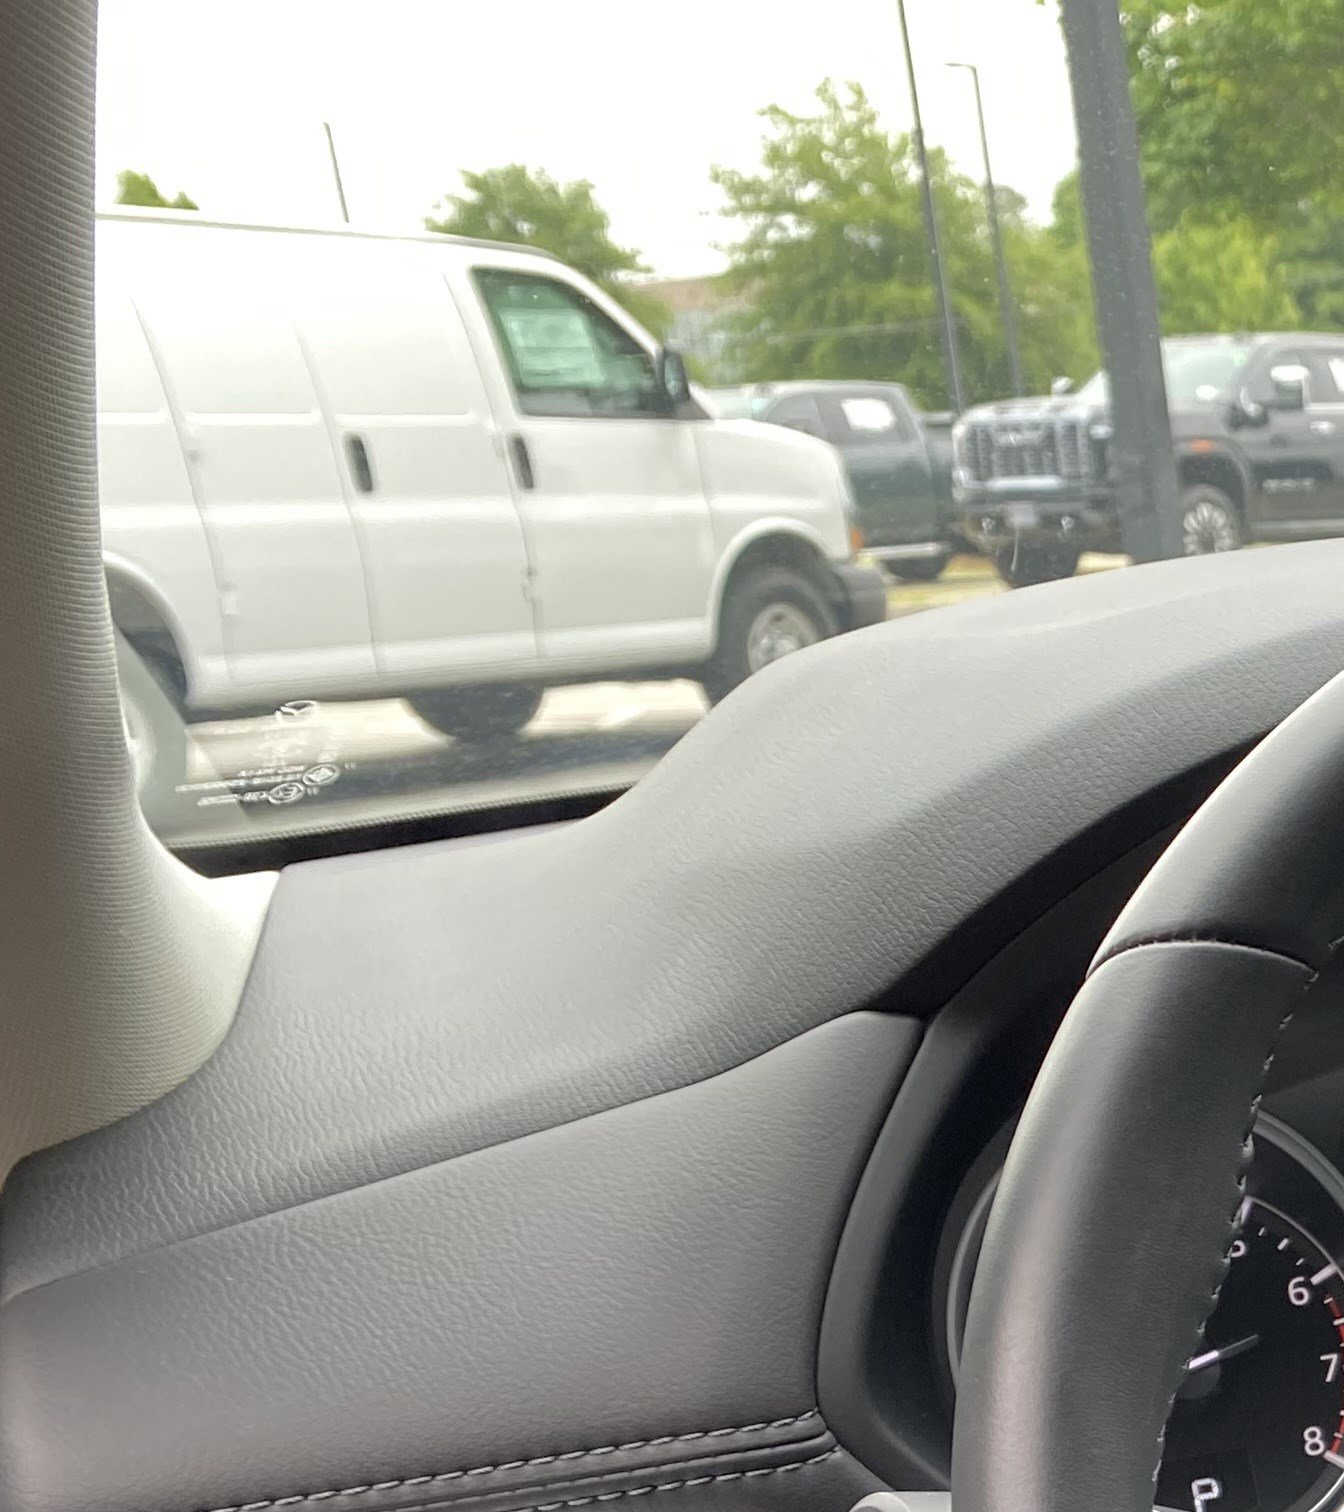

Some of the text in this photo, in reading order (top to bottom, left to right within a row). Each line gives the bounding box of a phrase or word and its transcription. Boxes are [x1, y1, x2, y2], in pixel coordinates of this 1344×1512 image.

[1287, 1276, 1310, 1306] 6
[1320, 1353, 1340, 1383] 7
[1302, 1426, 1325, 1456] 8
